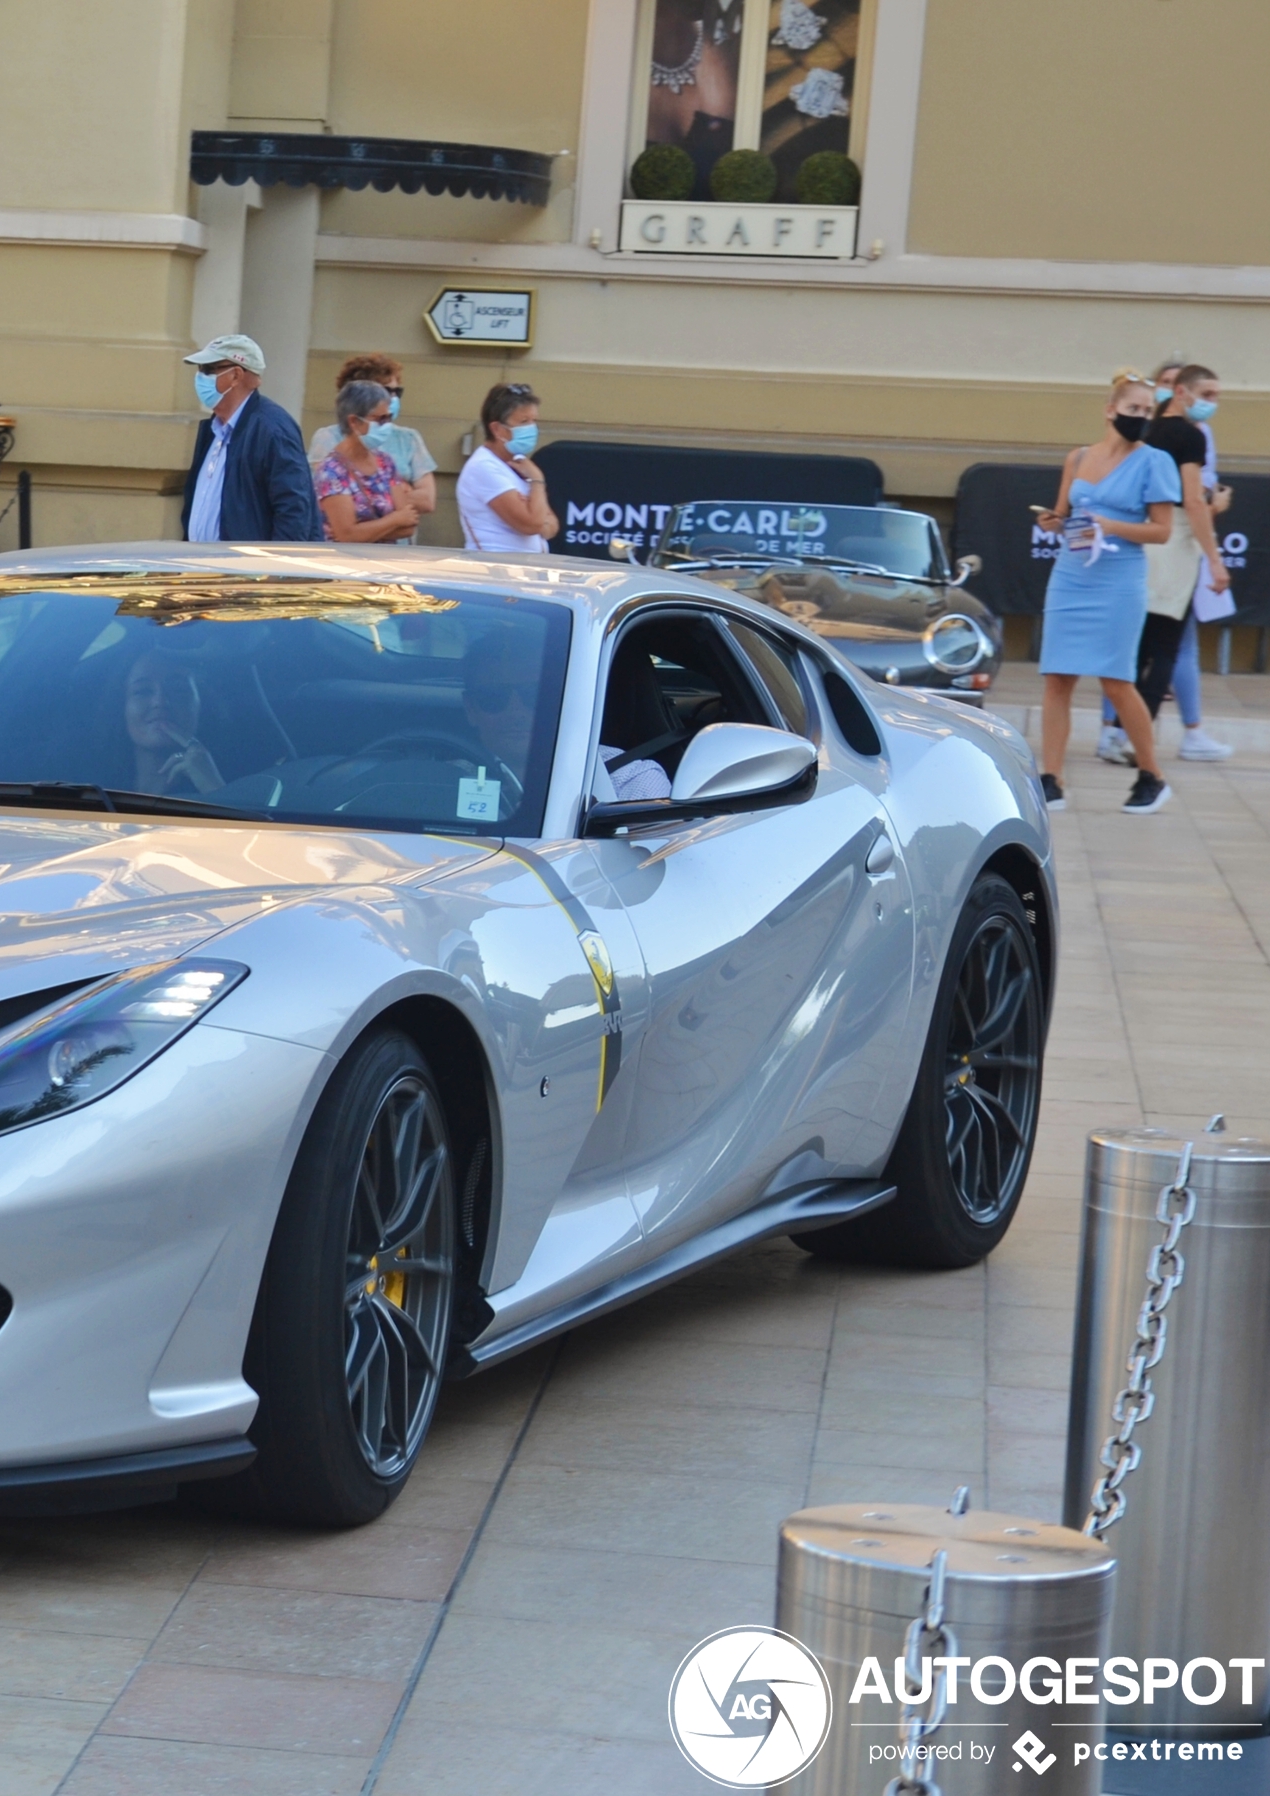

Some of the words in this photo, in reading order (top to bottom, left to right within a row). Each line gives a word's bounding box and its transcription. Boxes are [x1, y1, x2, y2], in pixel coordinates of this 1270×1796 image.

[640, 213, 837, 249] GRAFF
[476, 306, 525, 317] ASCENSEUR
[490, 319, 510, 329] LIFT
